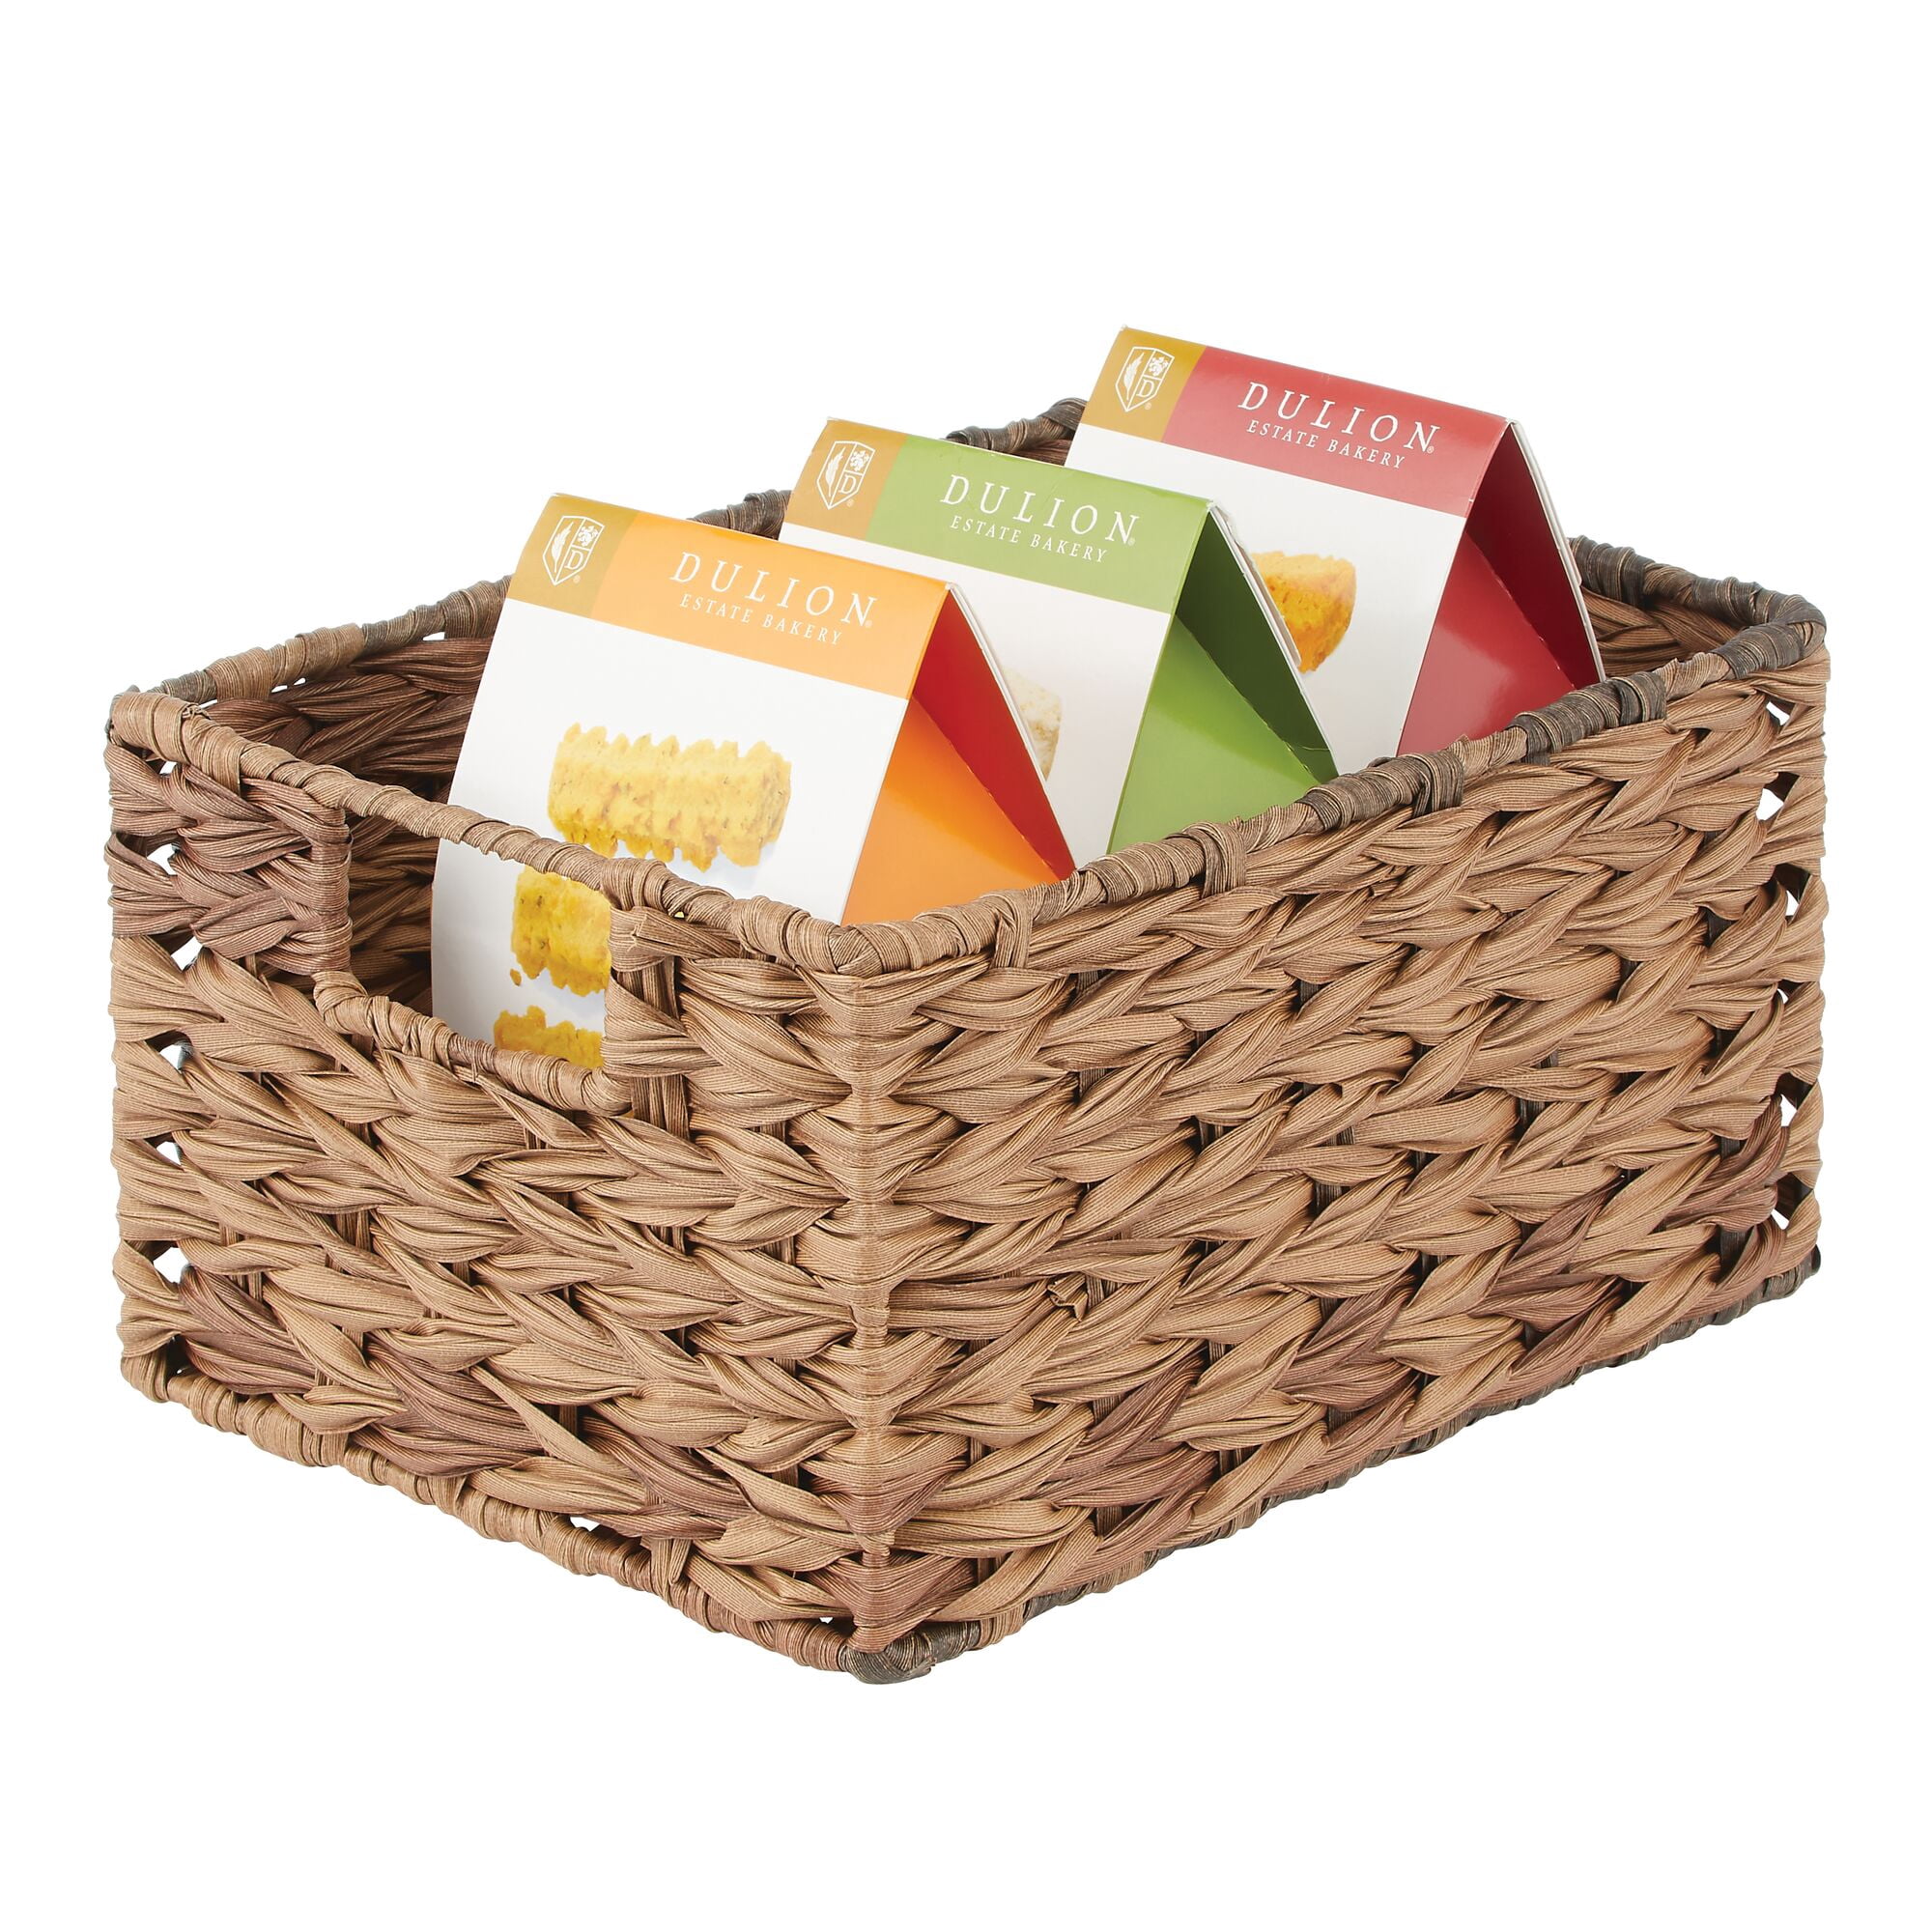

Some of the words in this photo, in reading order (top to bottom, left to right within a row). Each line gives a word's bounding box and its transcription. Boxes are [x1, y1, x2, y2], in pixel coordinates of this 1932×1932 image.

[1136, 377, 1155, 398] D
[1238, 382, 1440, 452] DULION
[1247, 420, 1319, 448] ESTATE
[1326, 440, 1406, 469] BAKERY
[838, 472, 858, 495] D
[940, 474, 1140, 545] DULION
[564, 549, 584, 570] D
[951, 516, 1021, 543] ESTATE
[1031, 533, 1108, 563] BAKERY
[669, 552, 878, 627] DULION
[680, 593, 753, 623] ESTATE
[762, 613, 842, 645] BAKERY
